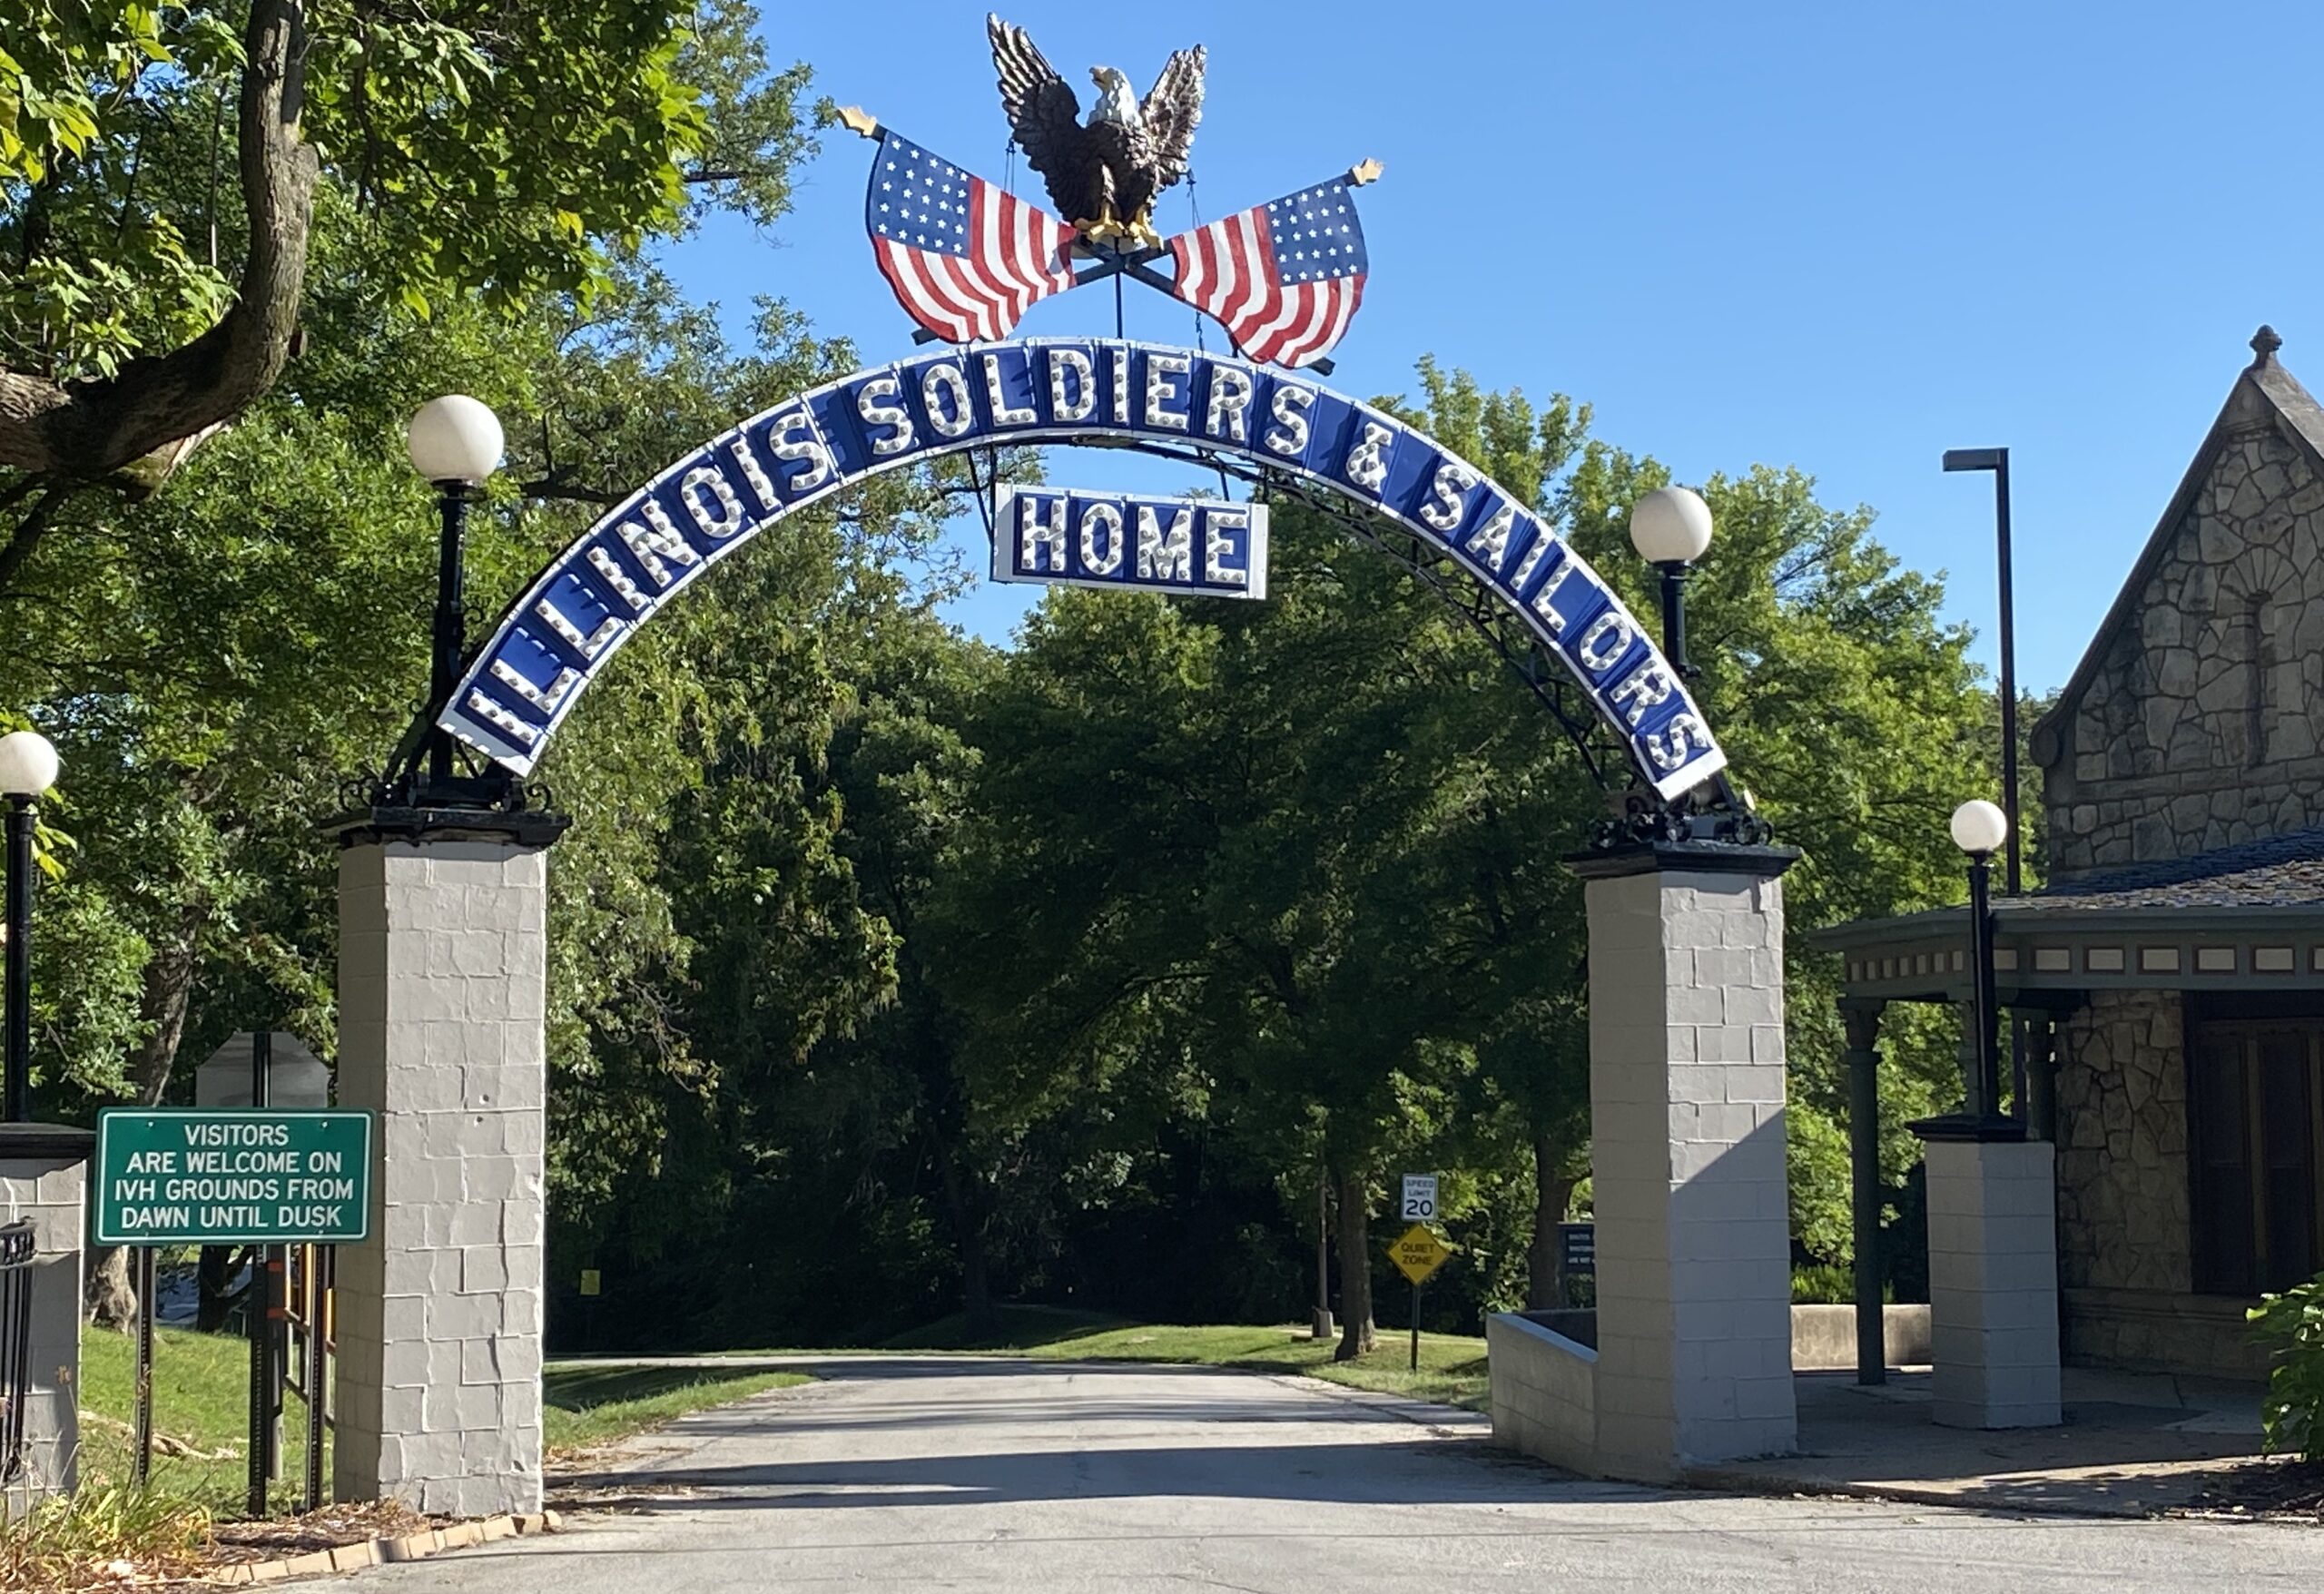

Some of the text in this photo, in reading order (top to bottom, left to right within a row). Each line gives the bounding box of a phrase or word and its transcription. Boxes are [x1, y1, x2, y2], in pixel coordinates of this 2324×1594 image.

[1020, 497, 1247, 584] HOME
[467, 349, 1712, 771] ILLINOIS SOLDIERS & SAILORS
[184, 1124, 289, 1146] VISITORS
[125, 1152, 341, 1174] ARE WELCOME ON
[114, 1178, 353, 1201] IVH GROUNDS FROM
[1405, 1180, 1434, 1188] SPEED
[122, 1205, 342, 1228] DAWN UNTIL DUSK
[1405, 1199, 1433, 1216] 20
[1401, 1242, 1434, 1253] QUIET
[1403, 1255, 1433, 1265] ZONE
